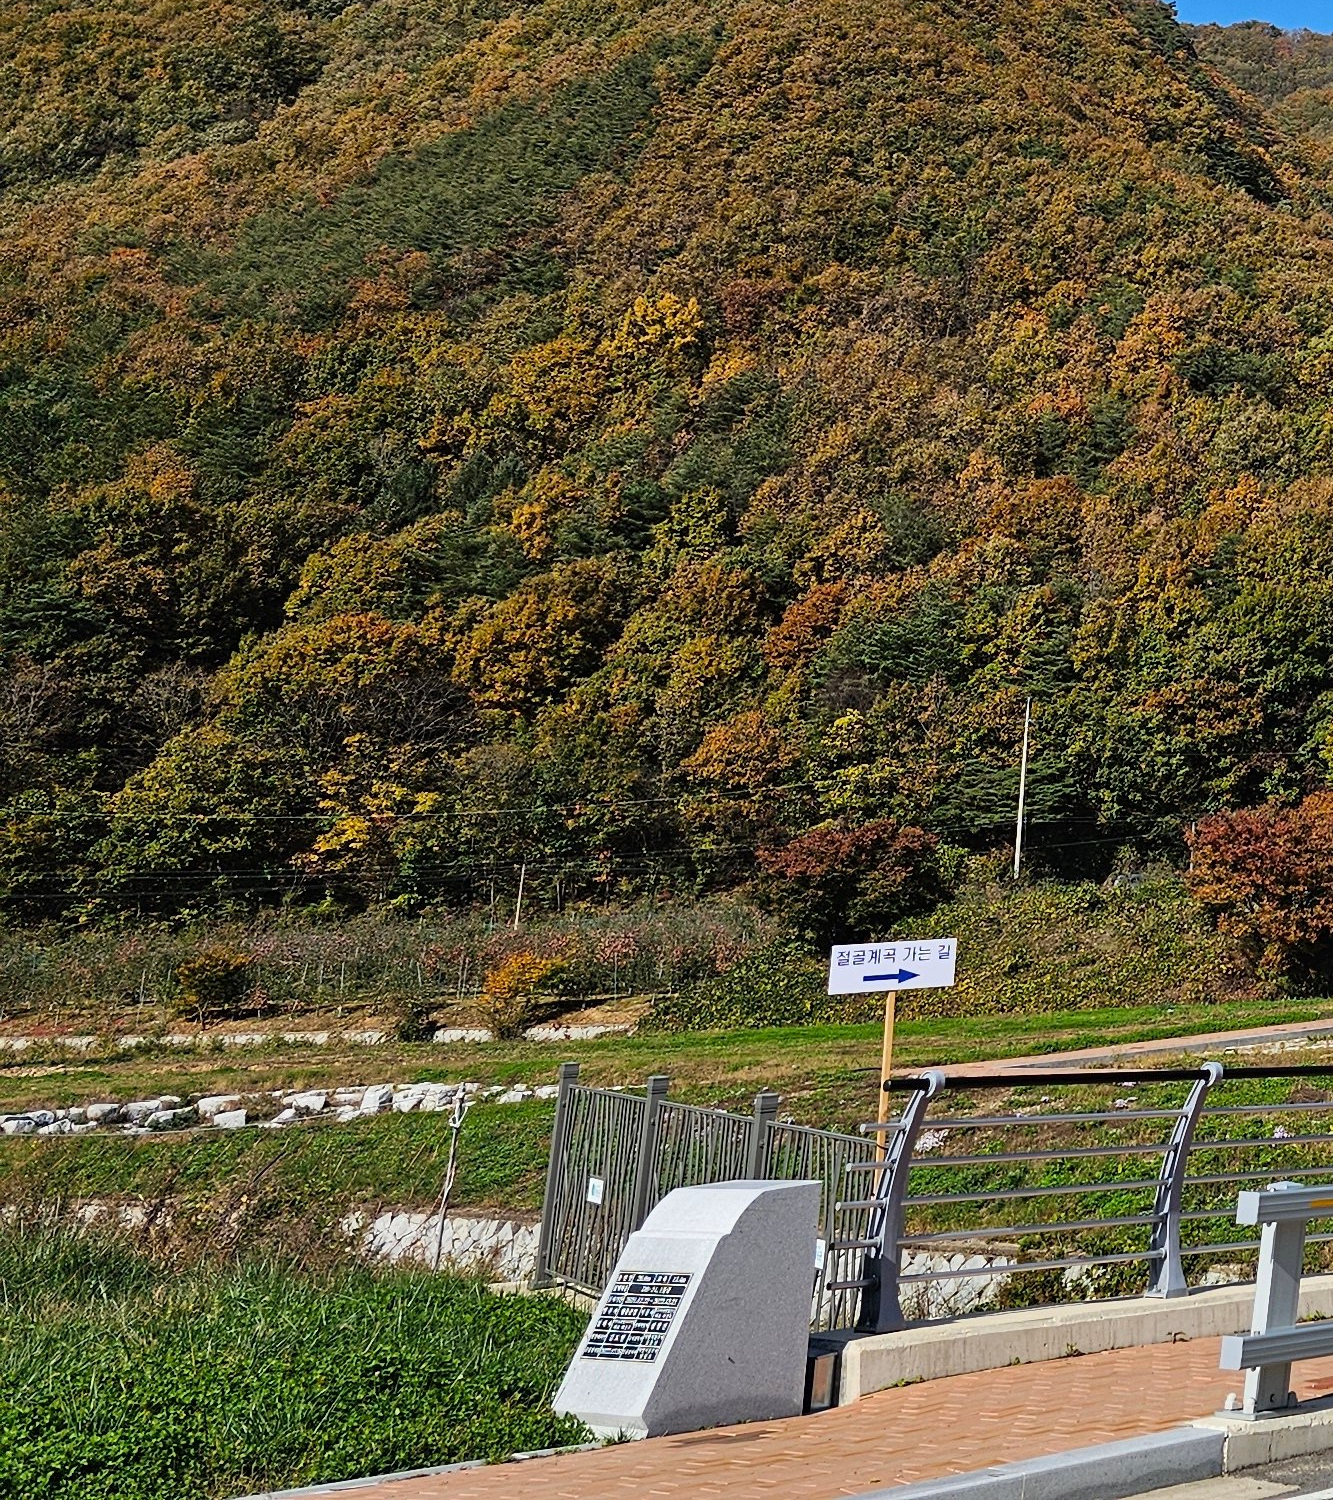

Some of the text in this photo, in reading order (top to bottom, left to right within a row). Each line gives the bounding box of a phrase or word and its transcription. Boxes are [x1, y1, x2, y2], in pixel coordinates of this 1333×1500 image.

[836, 944, 951, 967] 절골계곡 가는 길
